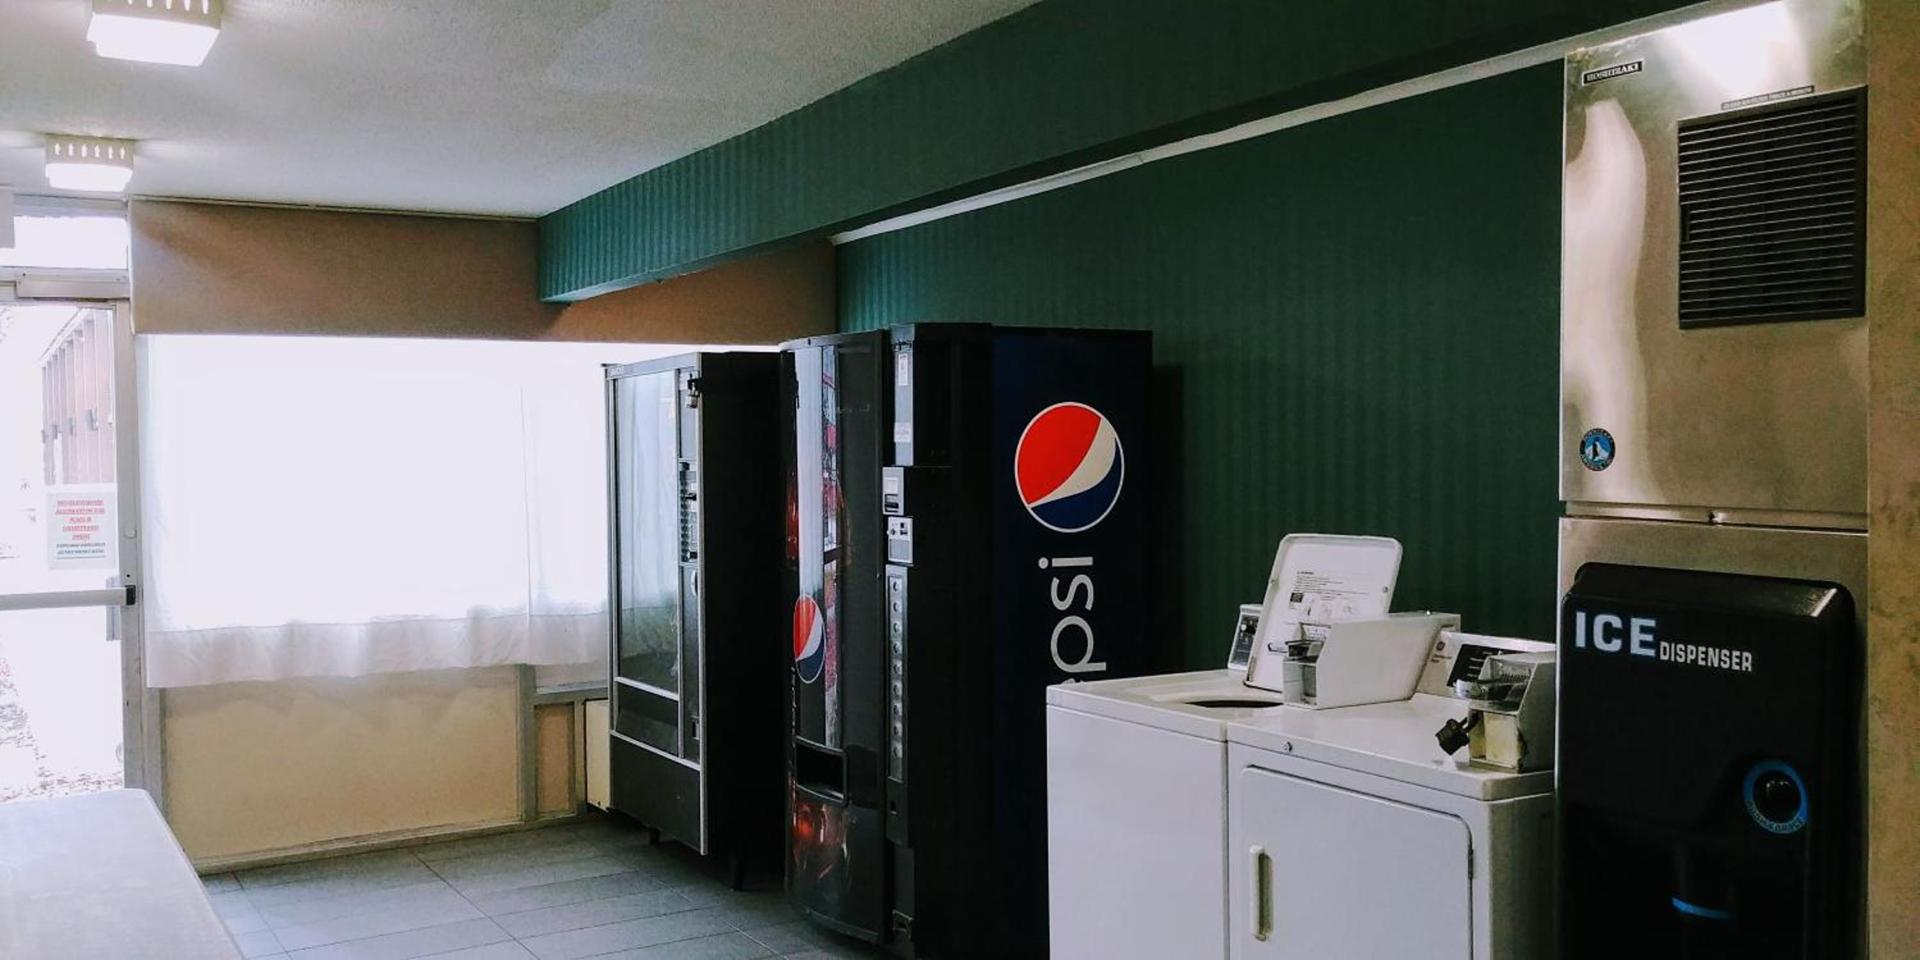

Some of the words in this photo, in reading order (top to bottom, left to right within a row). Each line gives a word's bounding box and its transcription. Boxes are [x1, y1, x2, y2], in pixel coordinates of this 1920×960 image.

[1587, 63, 1639, 80] HOSHIZAKI
[1037, 556, 1107, 684] psi
[1575, 611, 1656, 657] ICE
[1660, 641, 1752, 672] DISPENSER
